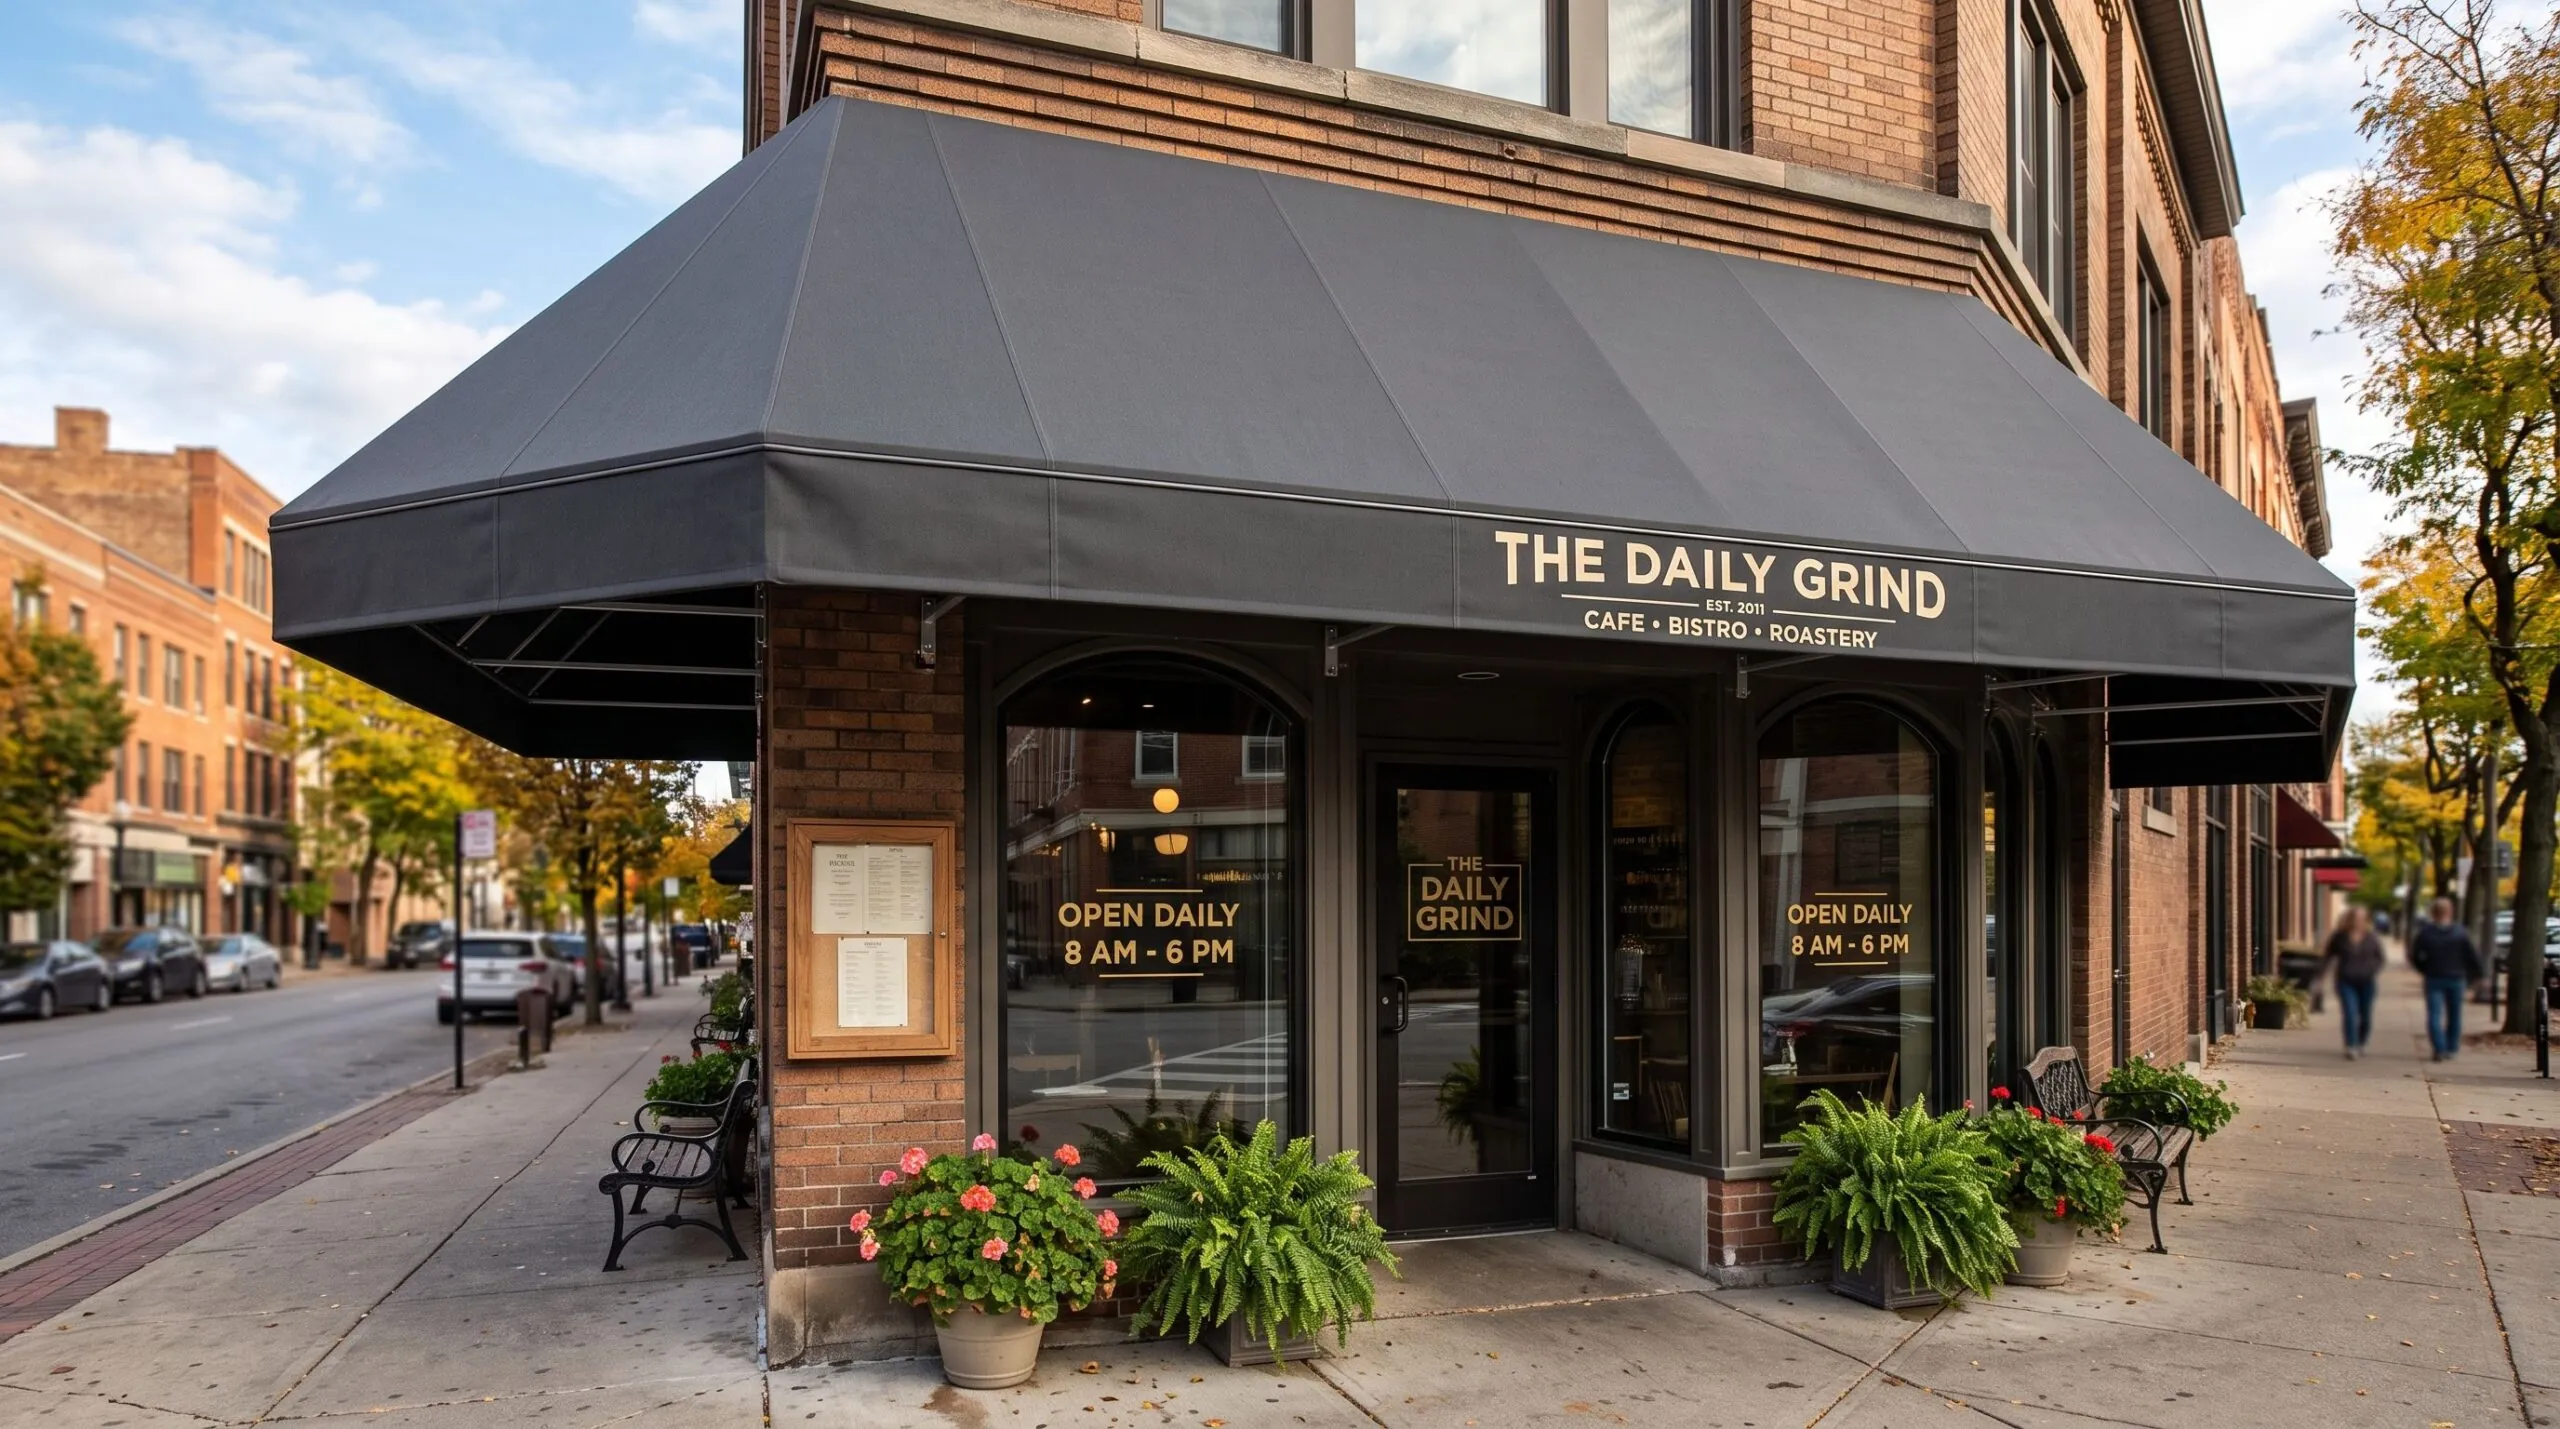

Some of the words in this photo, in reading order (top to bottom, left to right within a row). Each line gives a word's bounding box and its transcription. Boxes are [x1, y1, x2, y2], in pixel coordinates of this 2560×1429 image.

[1495, 530, 1605, 585] THE
[1626, 542, 1776, 594] DAILY
[1793, 558, 1946, 619] GRIND
[1706, 599, 1734, 613] EST.
[1737, 601, 1765, 616] 2011
[1584, 610, 1645, 633] CAFE
[1669, 616, 1748, 640] BISTRO
[1770, 624, 1878, 649] ROASTERY
[1447, 856, 1483, 871] THE
[1422, 876, 1510, 901] DAILY
[1058, 902, 1143, 928] OPEN
[1155, 903, 1240, 927] DAILY
[1416, 906, 1514, 931] GRIND
[1787, 903, 1847, 925] OPEN
[1853, 904, 1913, 924] DAILY
[1064, 940, 1082, 965] 8
[1090, 940, 1137, 965] AM
[1166, 939, 1184, 964] 6
[1193, 939, 1234, 964] PM
[1791, 935, 1804, 956] 8
[1809, 935, 1842, 955] AM
[1861, 934, 1874, 955] 6
[1880, 934, 1909, 954] PM
